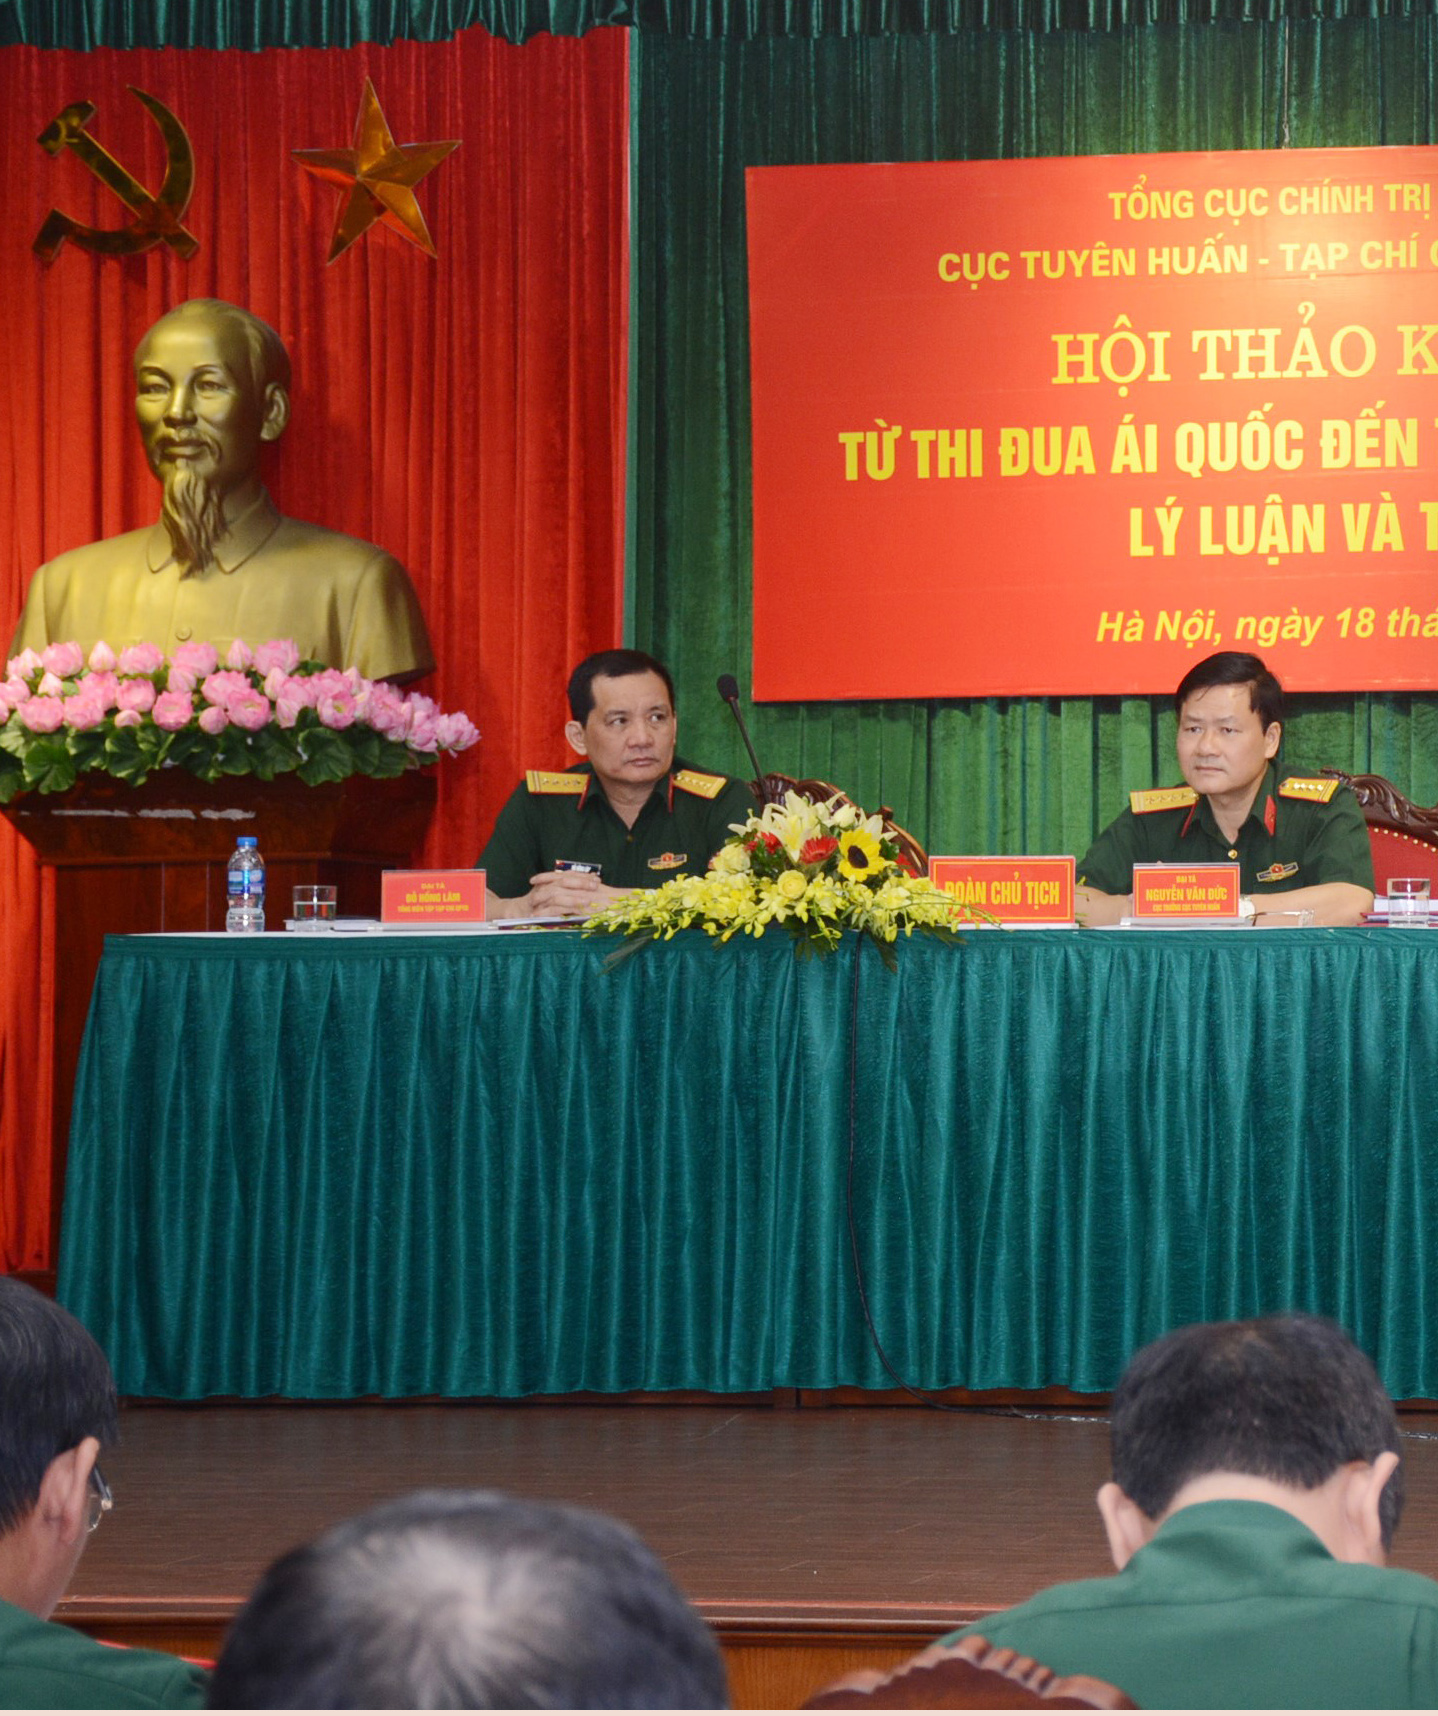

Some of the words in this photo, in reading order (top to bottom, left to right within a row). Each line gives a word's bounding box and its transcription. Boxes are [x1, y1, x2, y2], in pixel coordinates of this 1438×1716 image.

[1108, 174, 1194, 220] TỔNG
[1204, 187, 1269, 226] CỤC
[1278, 178, 1374, 216] CHÍNH
[1383, 181, 1431, 220] TRỊ
[938, 251, 1010, 290] CỤC
[1019, 241, 1136, 279] TUYÊN
[1148, 232, 1248, 276] HUẤN
[1278, 242, 1350, 281] TẠP
[1360, 232, 1419, 270] CHÍ
[1051, 314, 1171, 398] HỘI
[1191, 301, 1377, 381] THẢO
[838, 418, 902, 481] TỪ
[910, 428, 983, 479] THI
[998, 426, 1096, 477] ĐUA
[1110, 413, 1158, 474] ÁI
[1175, 402, 1304, 478] QUỐC
[1319, 400, 1418, 469] ĐẾN
[1129, 496, 1184, 557] LÝ
[1199, 493, 1325, 566] LUẬN
[1341, 491, 1405, 552] VÀ
[1096, 610, 1145, 642] Hà
[1154, 608, 1222, 649] Nội,
[1235, 607, 1325, 648] ngày
[1336, 606, 1376, 638] 18
[990, 871, 1022, 905] CHỦ
[1025, 880, 1060, 910] TỊCH
[1186, 886, 1206, 901] VĂN
